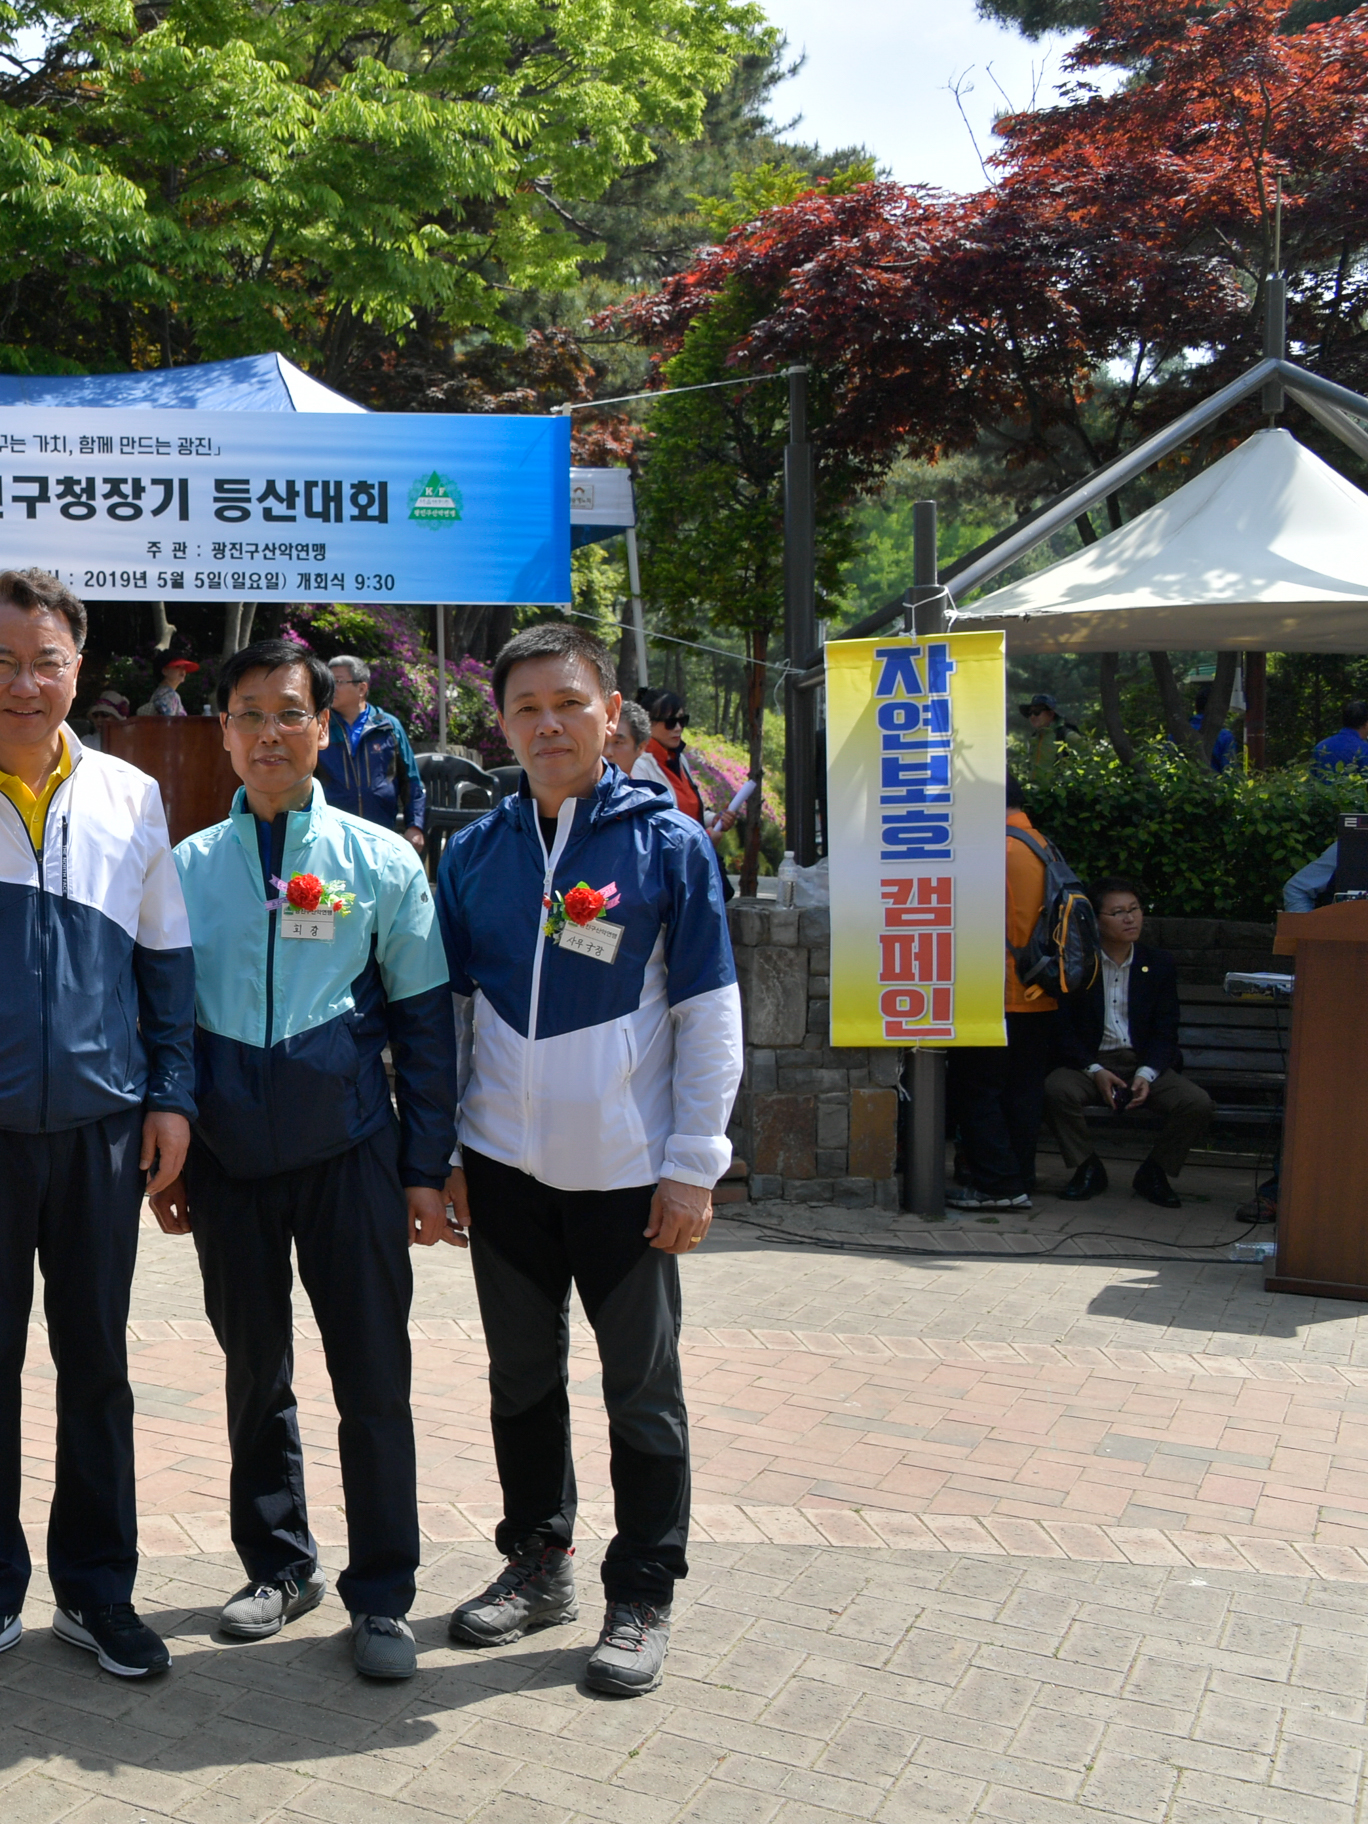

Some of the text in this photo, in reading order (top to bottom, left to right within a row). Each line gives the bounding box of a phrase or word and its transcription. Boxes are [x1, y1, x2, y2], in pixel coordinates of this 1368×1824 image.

[32, 435, 73, 457] 가치,
[79, 435, 113, 455] 함께
[120, 436, 172, 456] 만드는
[213, 478, 389, 524] 등산대회
[211, 542, 327, 561] 광진구산악연맹
[84, 570, 148, 589] 2019년
[157, 571, 185, 590] 5월
[194, 571, 287, 591] 5일(일요일)
[296, 572, 346, 591] 개회식
[355, 574, 395, 591] 9:30
[873, 642, 956, 863] 자연보호
[878, 876, 955, 1040] 캠페인
